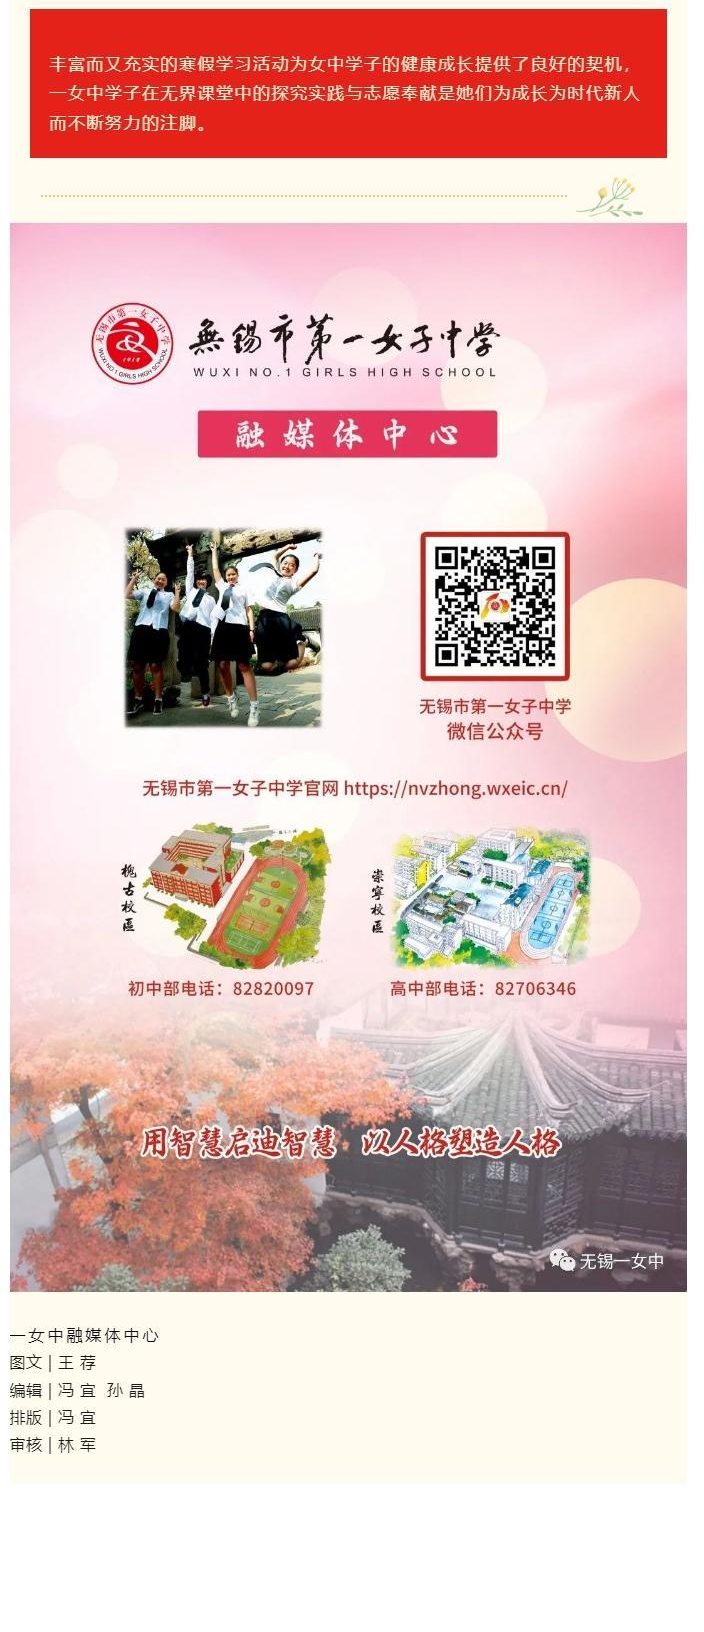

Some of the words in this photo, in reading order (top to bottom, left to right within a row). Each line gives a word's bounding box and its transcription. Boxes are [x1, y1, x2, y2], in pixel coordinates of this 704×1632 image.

[194, 367, 239, 378] WUXI
[250, 367, 291, 378] NO.1
[302, 367, 358, 378] GIRLS
[368, 367, 412, 378] HIGH
[422, 367, 497, 378] SCHOOL
[236, 417, 459, 450] 融媒体中心
[419, 697, 573, 717] 无锡市第一女子中学
[447, 721, 544, 742] 微信公众号
[142, 780, 340, 798] 无锡市第一女子中学官网
[344, 779, 568, 799] https://nvzhong.wxeic.cn/
[141, 1126, 337, 1159] 用智慧启迪智慧
[362, 1126, 562, 1159] 以人格塑造人格
[10, 1327, 158, 1343] 一女中融媒体中心
[10, 1354, 42, 1370] 图文
[10, 1383, 42, 1398] 编辑
[10, 1410, 42, 1425] 排版
[10, 1437, 42, 1453] 审核
